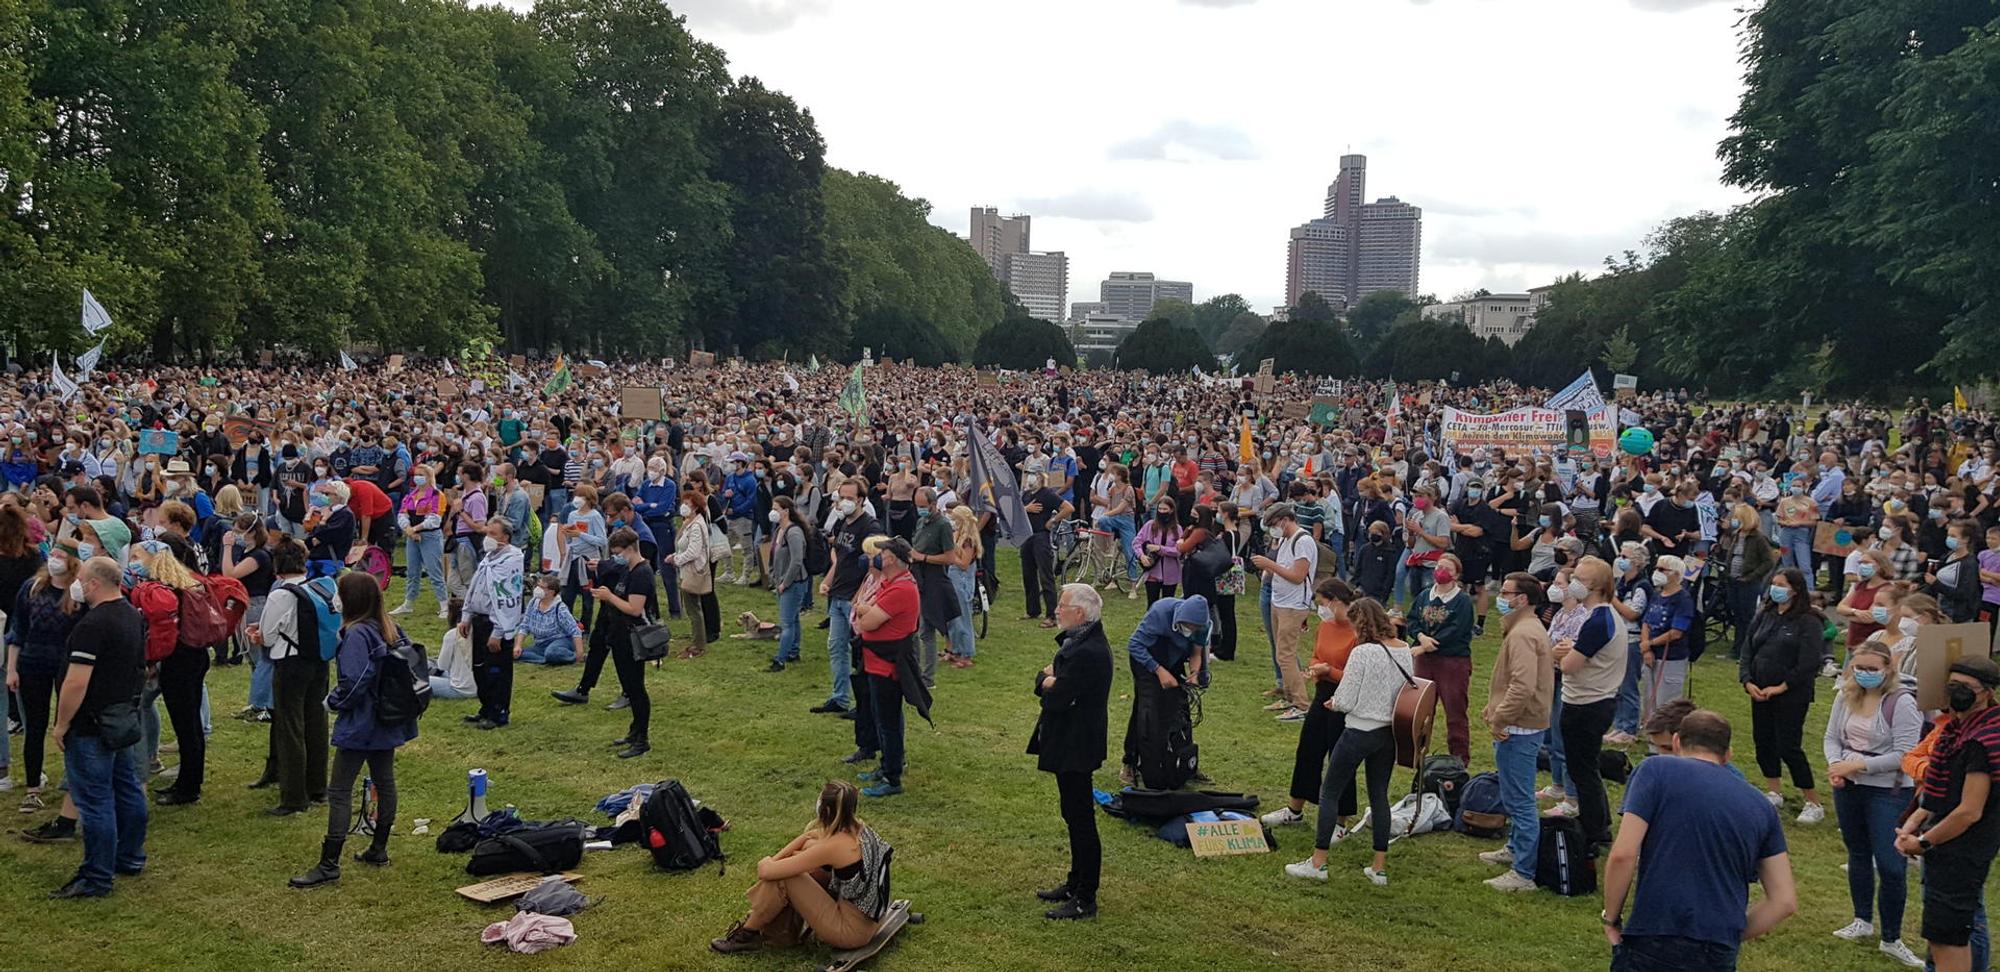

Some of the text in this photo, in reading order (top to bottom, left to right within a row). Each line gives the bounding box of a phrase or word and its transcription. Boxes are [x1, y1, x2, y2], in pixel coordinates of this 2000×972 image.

[1447, 421, 1468, 431] CETA
[1493, 431, 1510, 440] den
[1512, 431, 1567, 440] Klimawand
[1197, 823, 1239, 837] #ALLE
[1227, 836, 1266, 850] KLIMA
